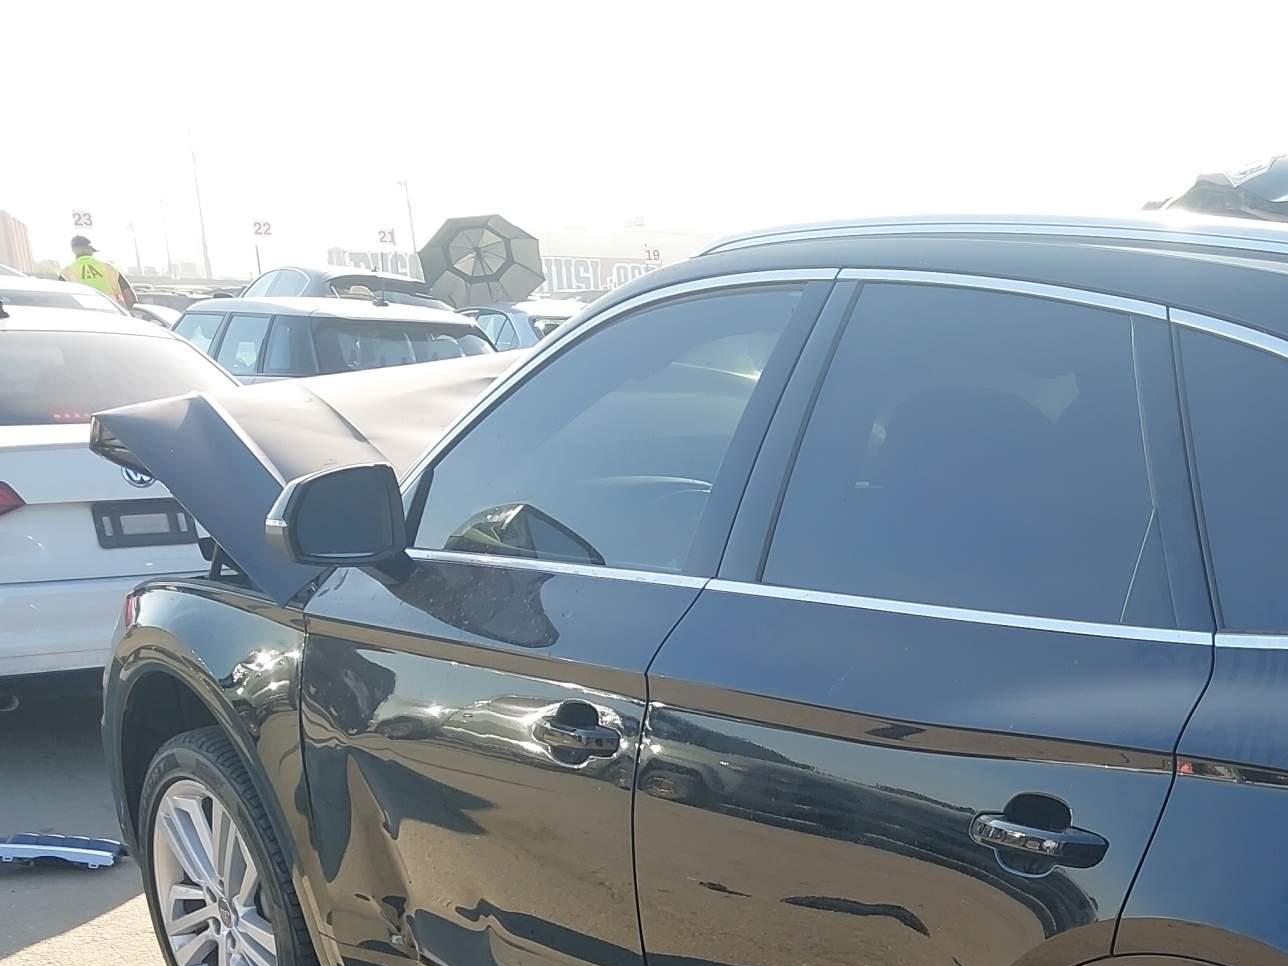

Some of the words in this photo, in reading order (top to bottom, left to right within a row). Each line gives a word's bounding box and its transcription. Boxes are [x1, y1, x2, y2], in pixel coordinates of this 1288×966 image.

[72, 212, 93, 226] 23
[253, 222, 272, 236] 22
[378, 230, 395, 243] 21
[645, 249, 660, 261] 19
